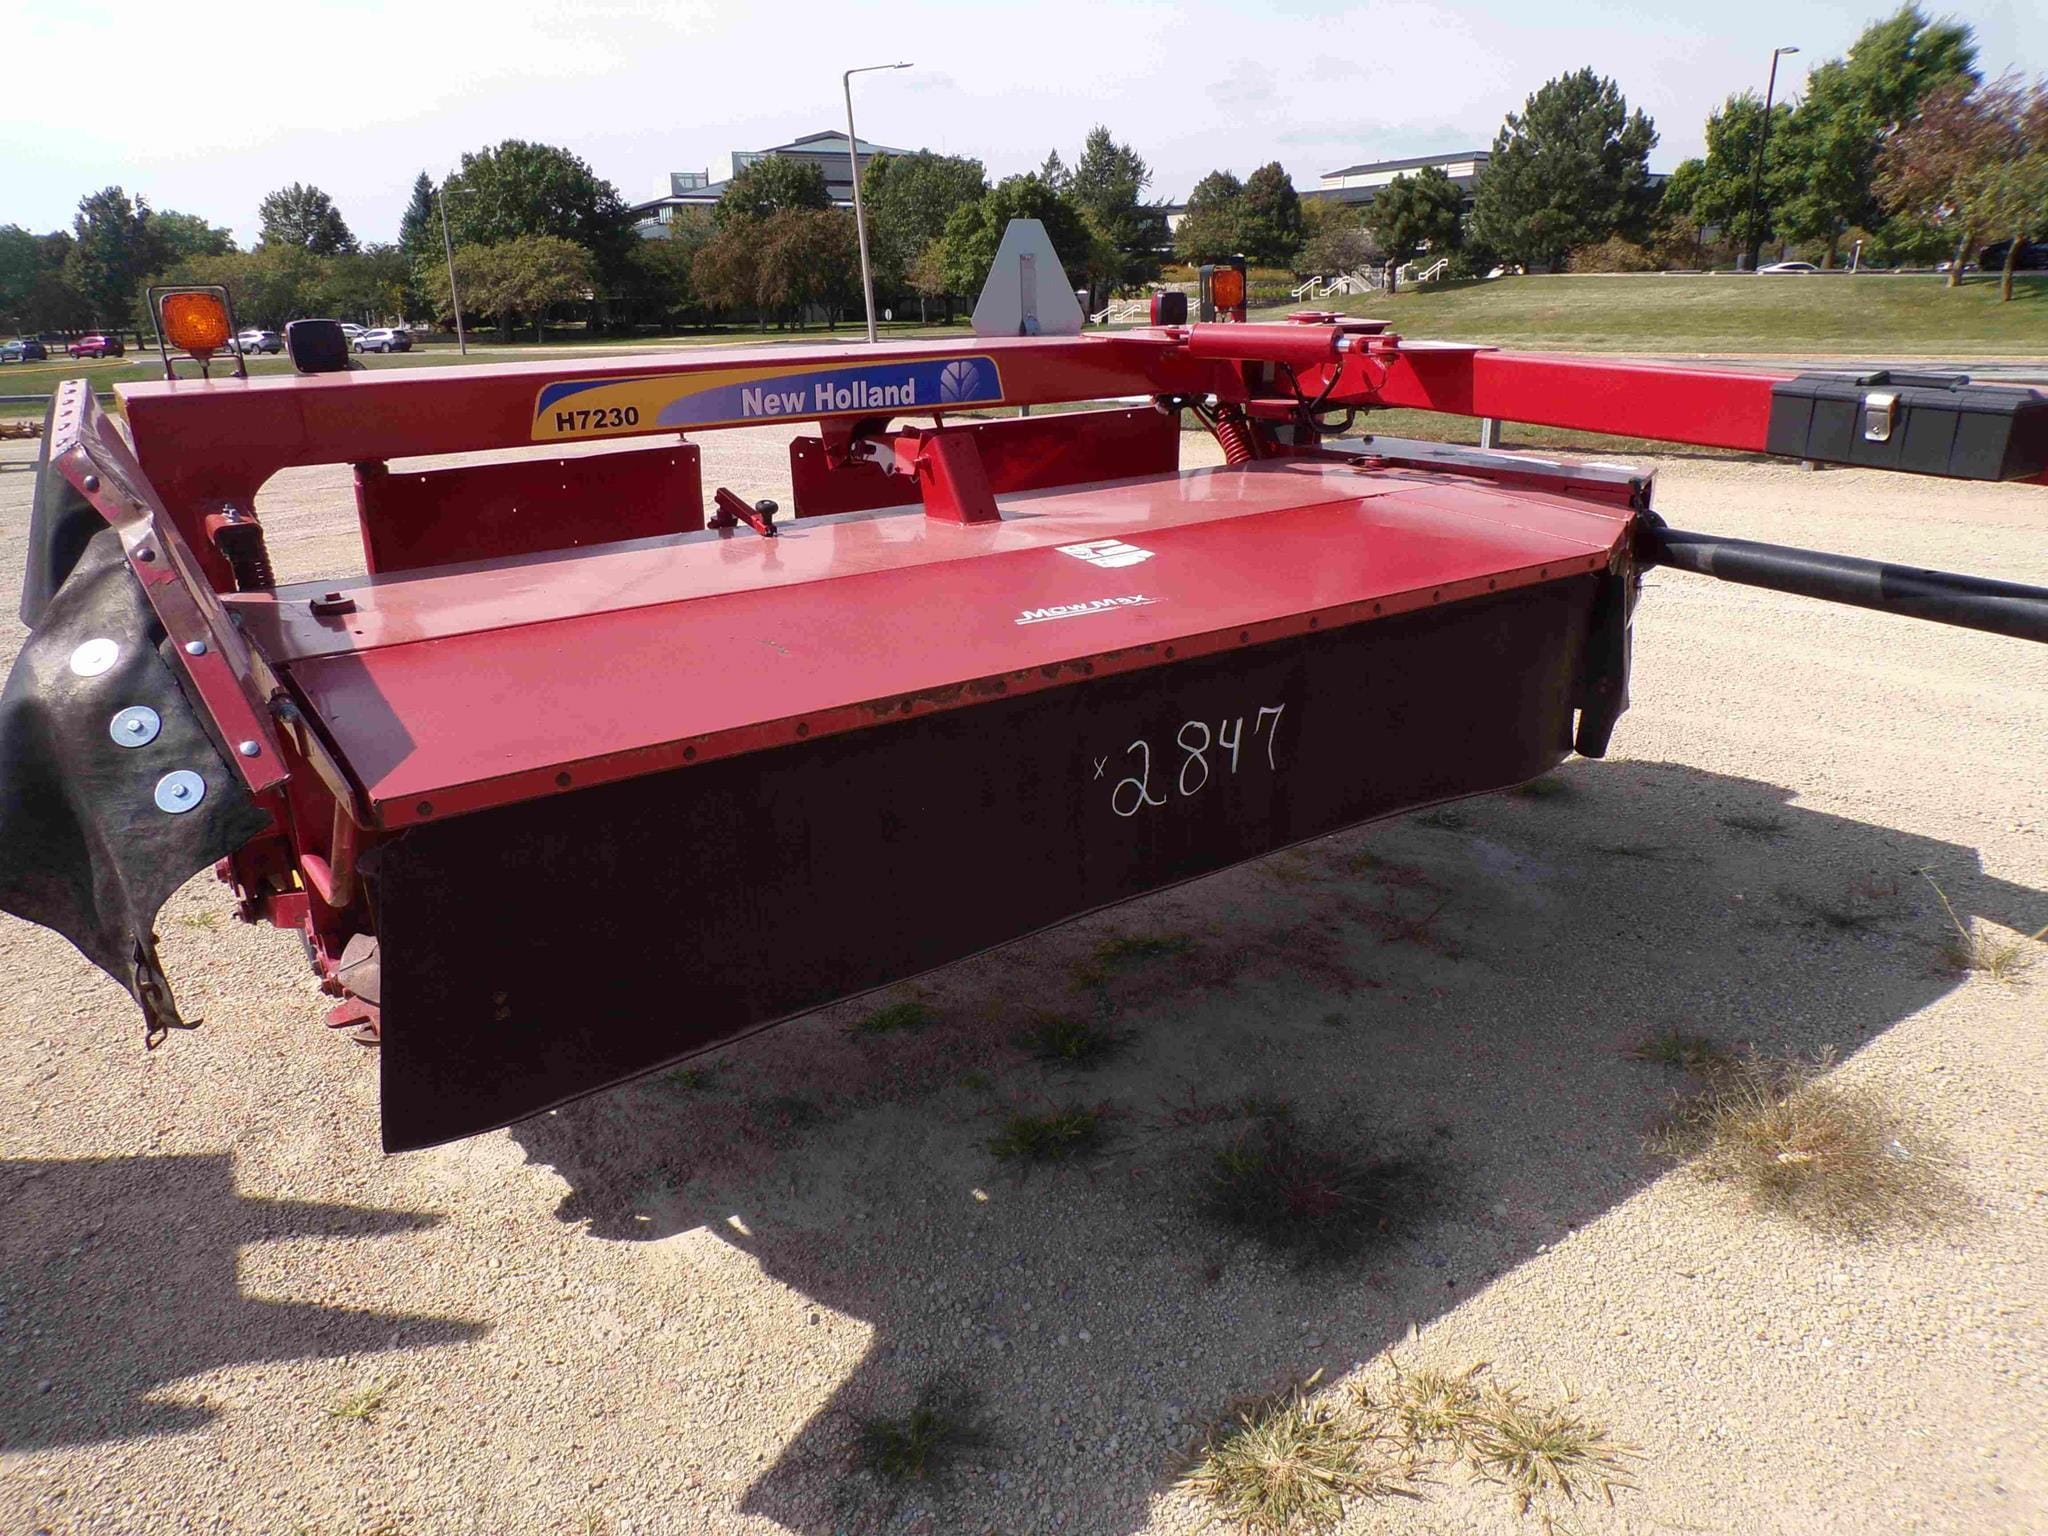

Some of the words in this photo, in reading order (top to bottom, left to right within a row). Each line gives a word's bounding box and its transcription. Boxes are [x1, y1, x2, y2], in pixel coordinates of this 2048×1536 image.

[743, 387, 805, 416] New
[815, 379, 915, 411] Holland
[556, 406, 639, 432] H7230
